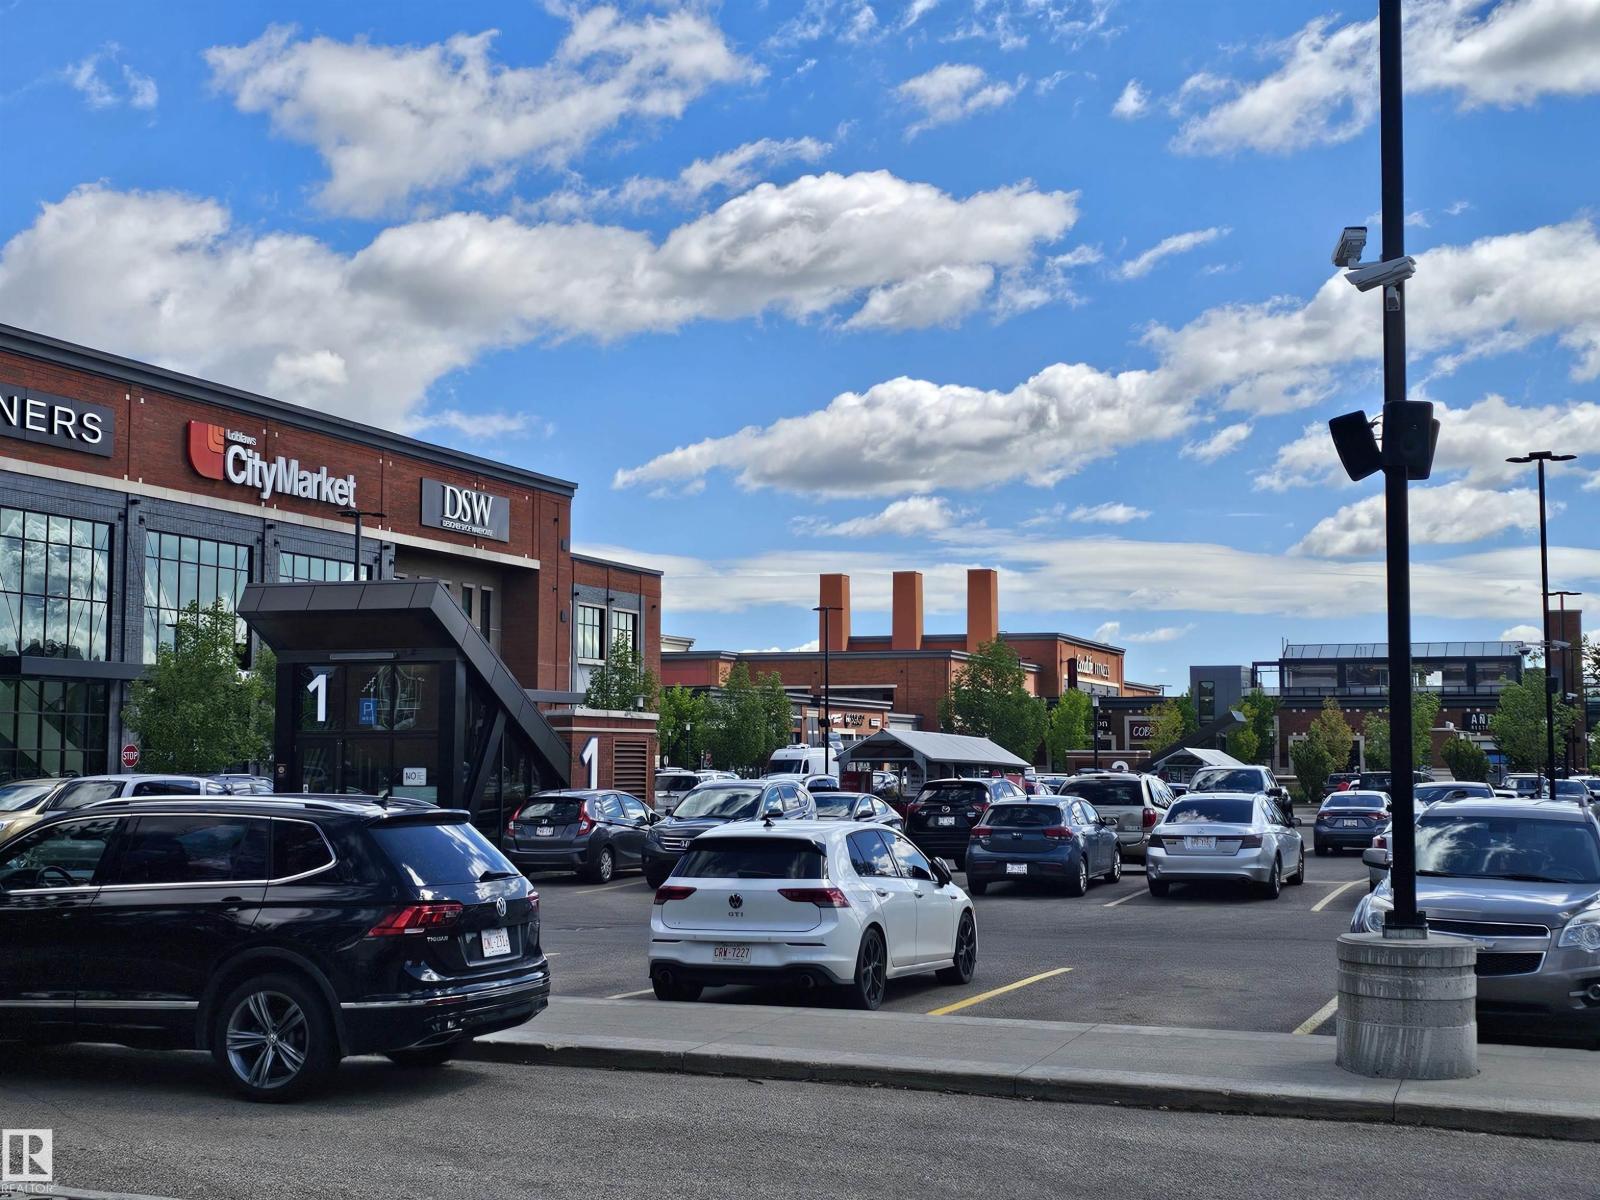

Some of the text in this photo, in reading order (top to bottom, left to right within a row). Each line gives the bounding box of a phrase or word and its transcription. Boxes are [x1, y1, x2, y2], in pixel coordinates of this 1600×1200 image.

[0, 394, 103, 444] NERS
[225, 444, 356, 508] CityMarket
[443, 485, 494, 526] DSW
[306, 674, 327, 722] 1
[123, 751, 138, 760] STOP
[405, 771, 417, 781] NO
[581, 737, 599, 790] 1
[714, 947, 750, 959] CRW-7227
